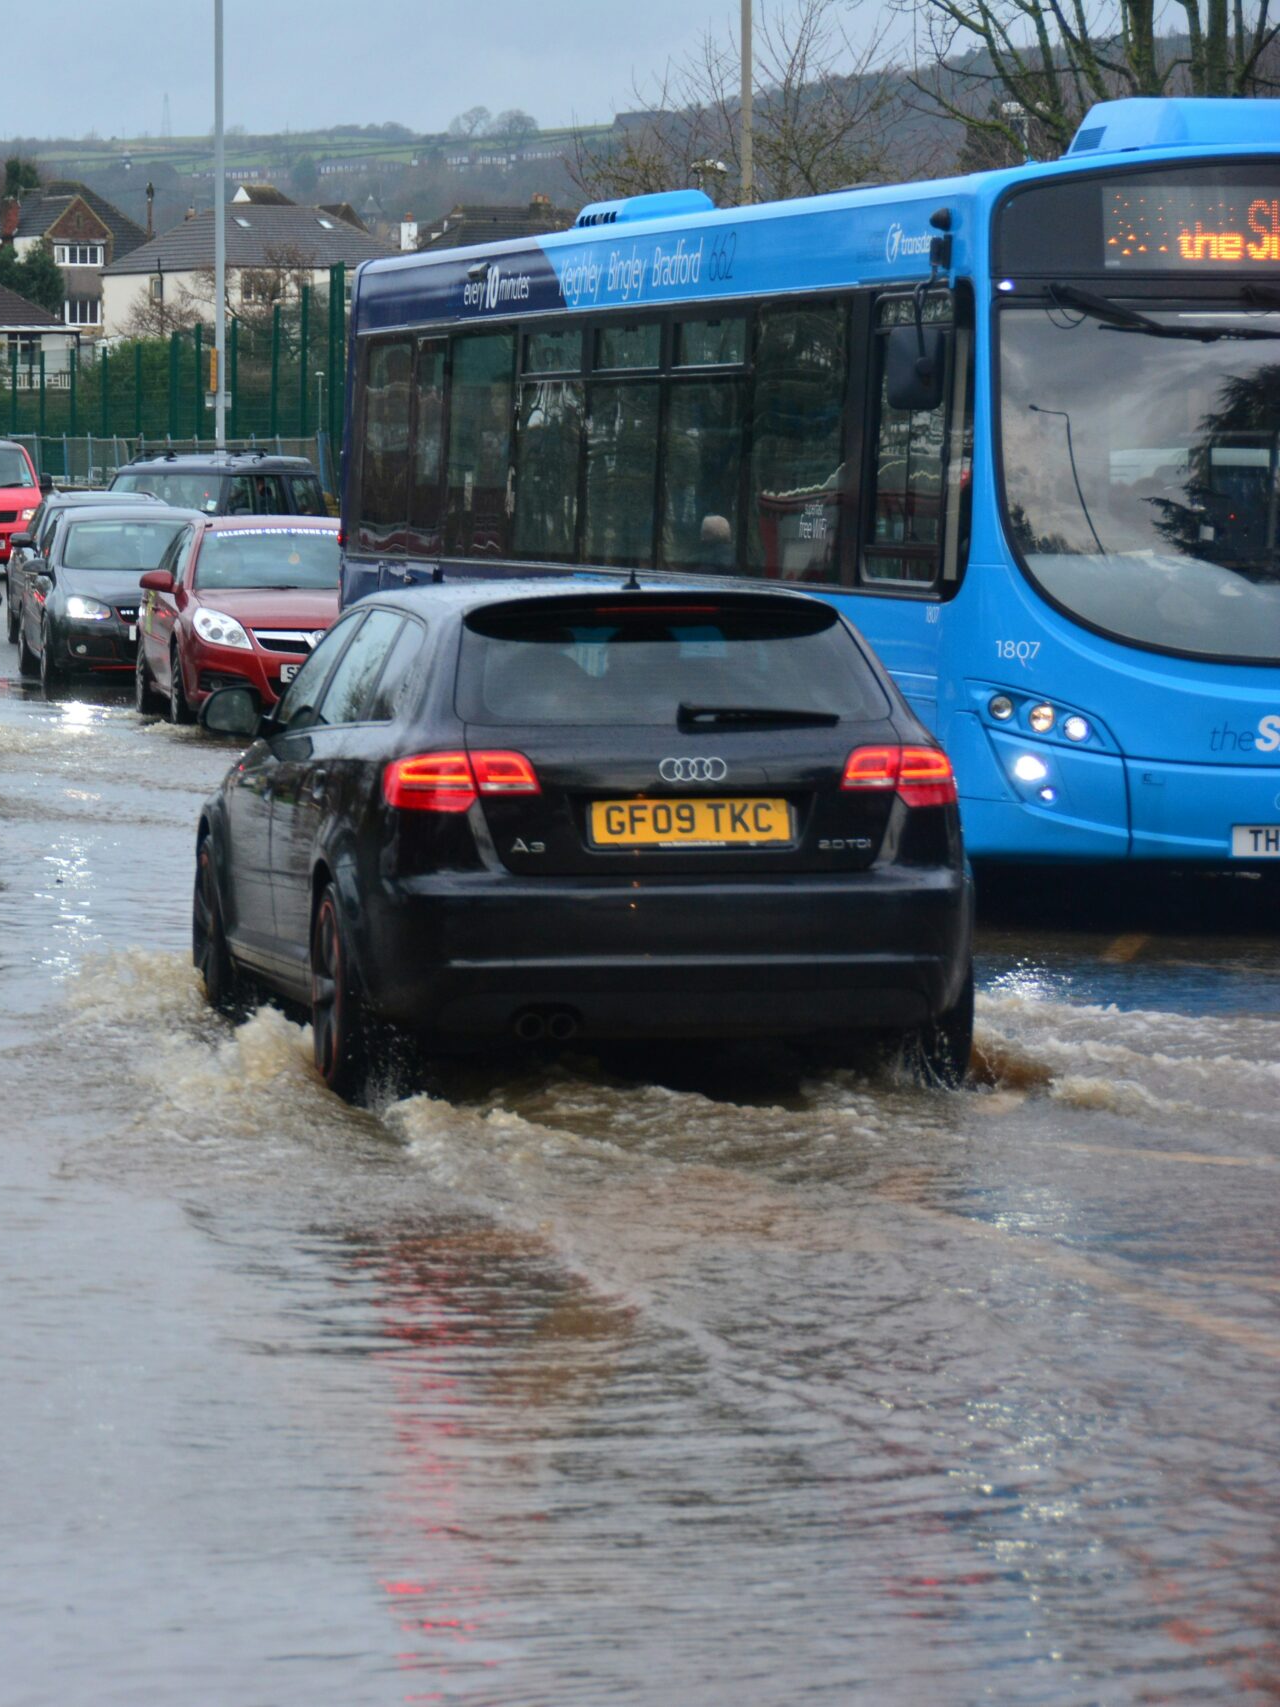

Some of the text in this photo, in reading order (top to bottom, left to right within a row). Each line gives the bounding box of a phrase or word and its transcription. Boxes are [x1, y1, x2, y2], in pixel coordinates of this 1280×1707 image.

[559, 231, 737, 304] Keighley Bingley Bradford 662
[463, 265, 530, 312] every 10 minutes
[217, 528, 262, 538] ALLERTON
[799, 514, 812, 539] free
[995, 639, 1040, 658] 1807
[605, 802, 773, 835] GF09 TKC
[511, 837, 546, 854] A3
[847, 837, 872, 850] TDI
